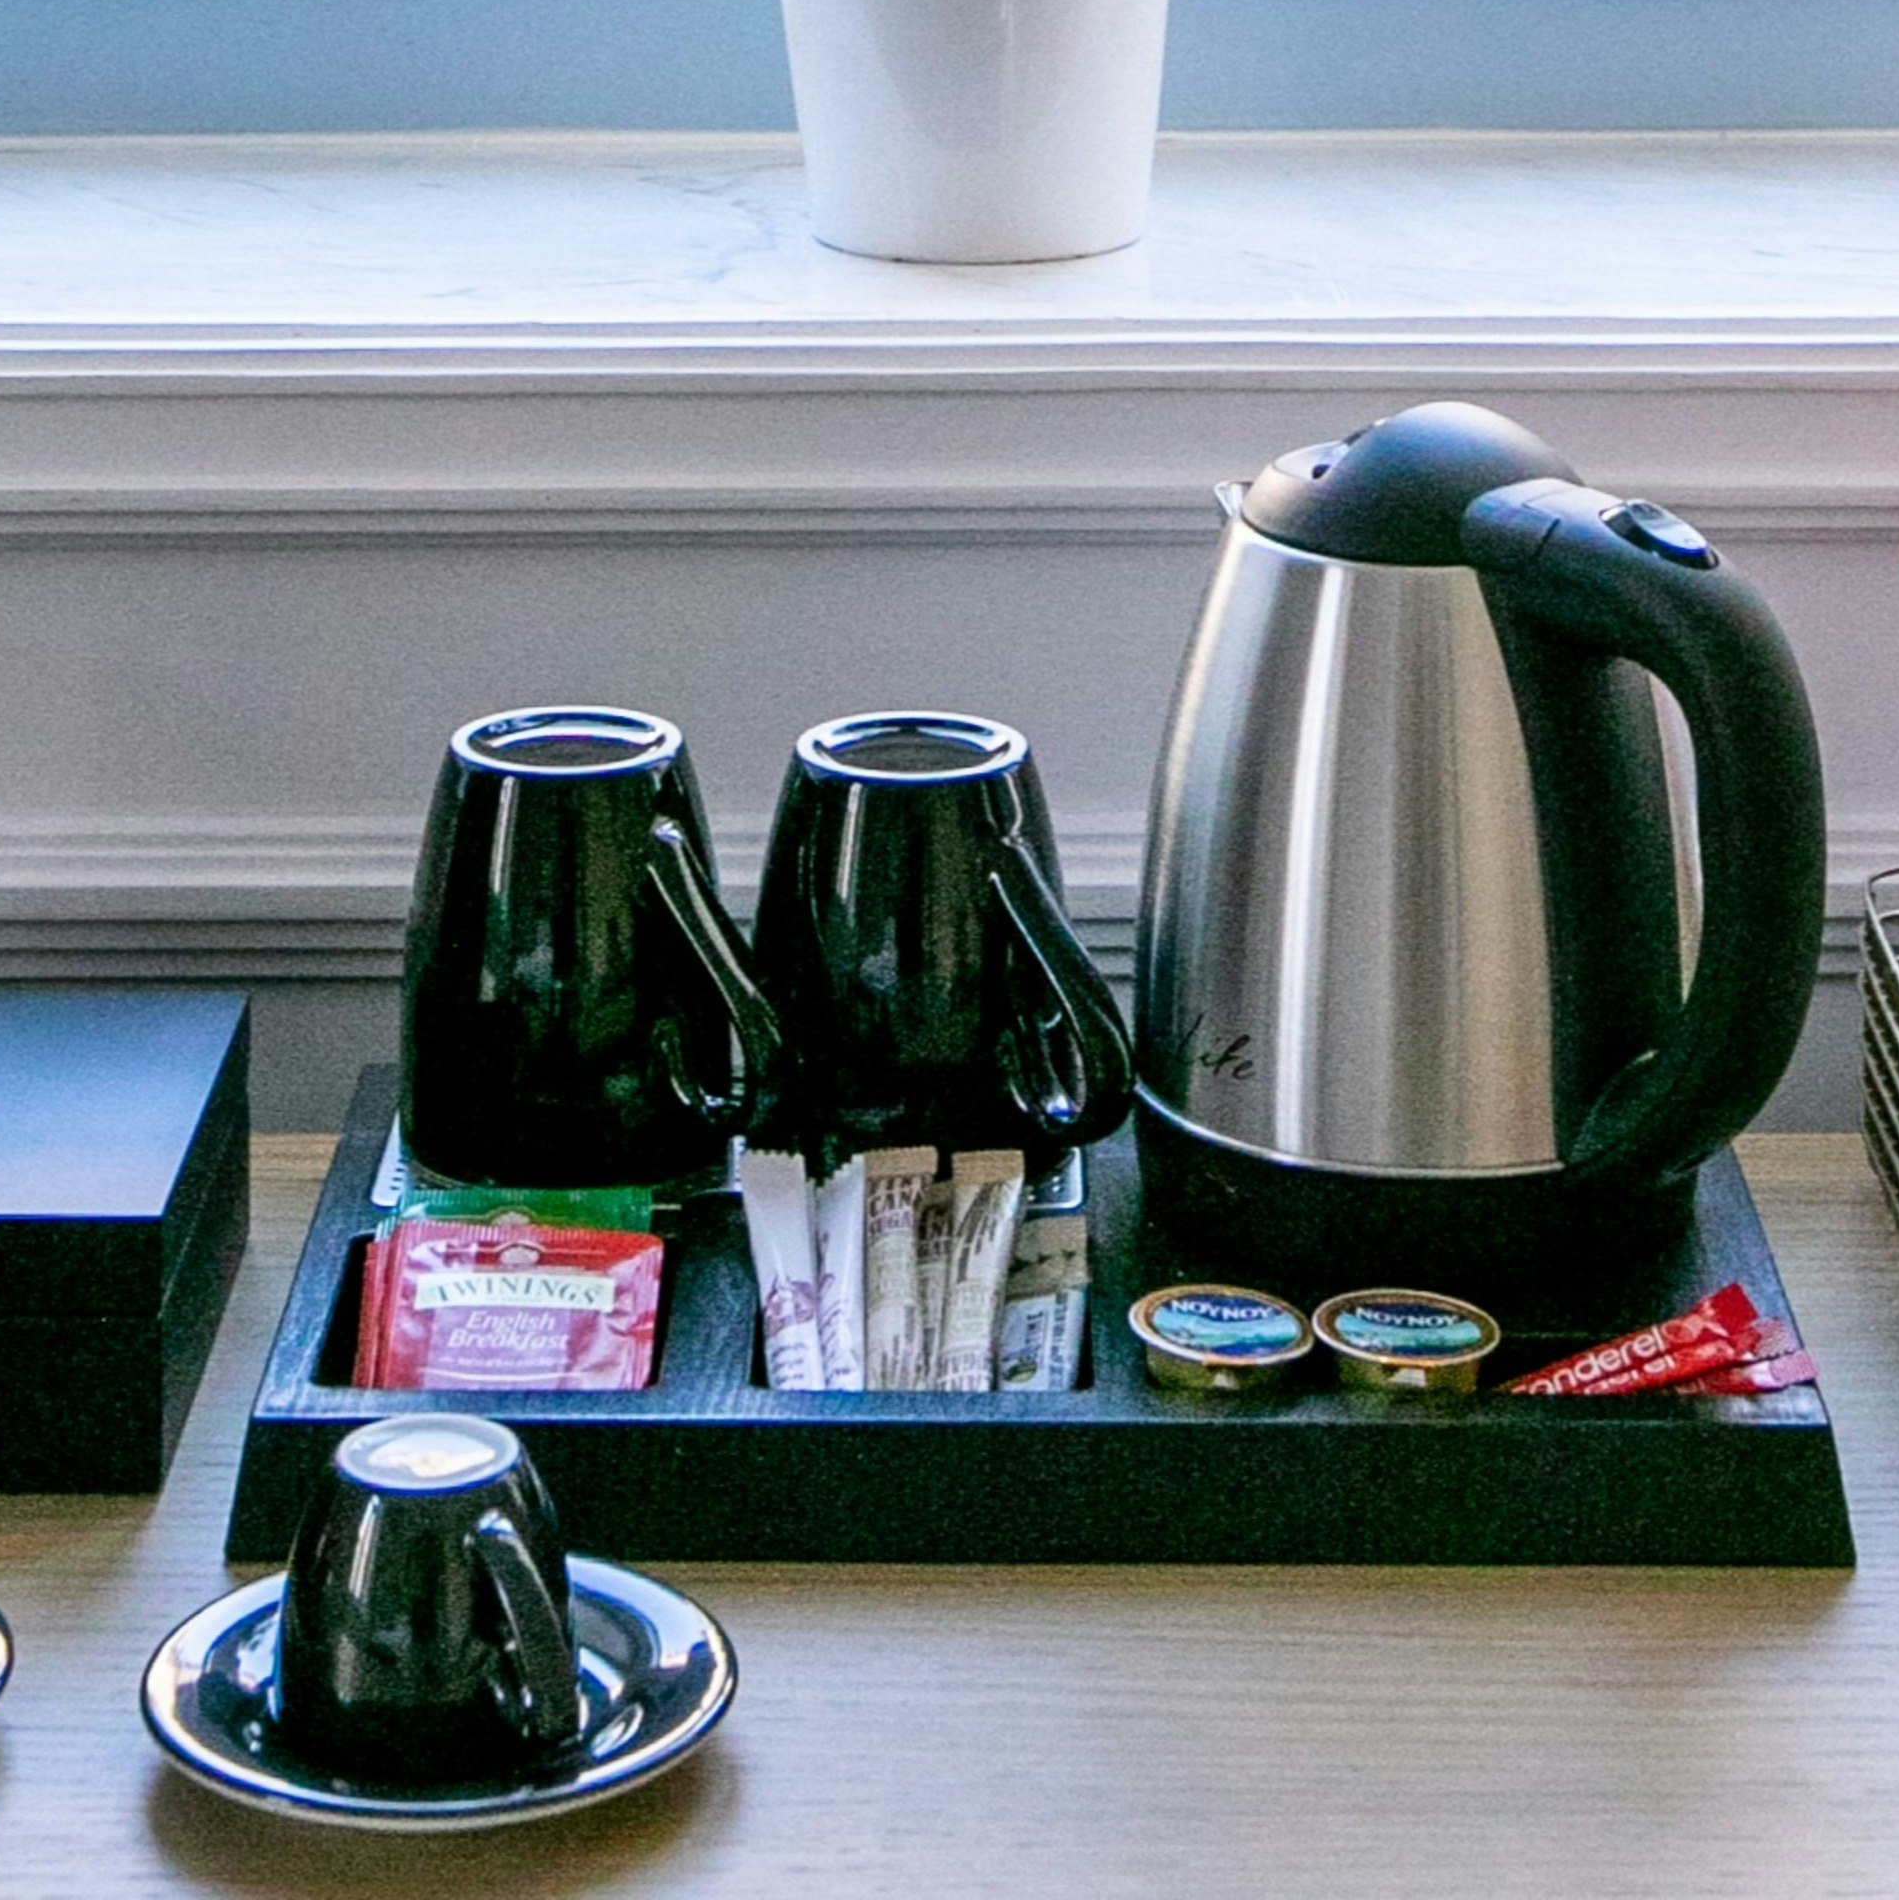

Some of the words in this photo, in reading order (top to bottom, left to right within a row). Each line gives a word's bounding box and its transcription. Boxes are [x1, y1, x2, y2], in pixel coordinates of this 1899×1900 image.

[432, 1275, 605, 1306] TWININGS
[466, 1310, 556, 1336] English
[447, 1327, 571, 1351] Breakfast
[1510, 1324, 1666, 1395] anderel
